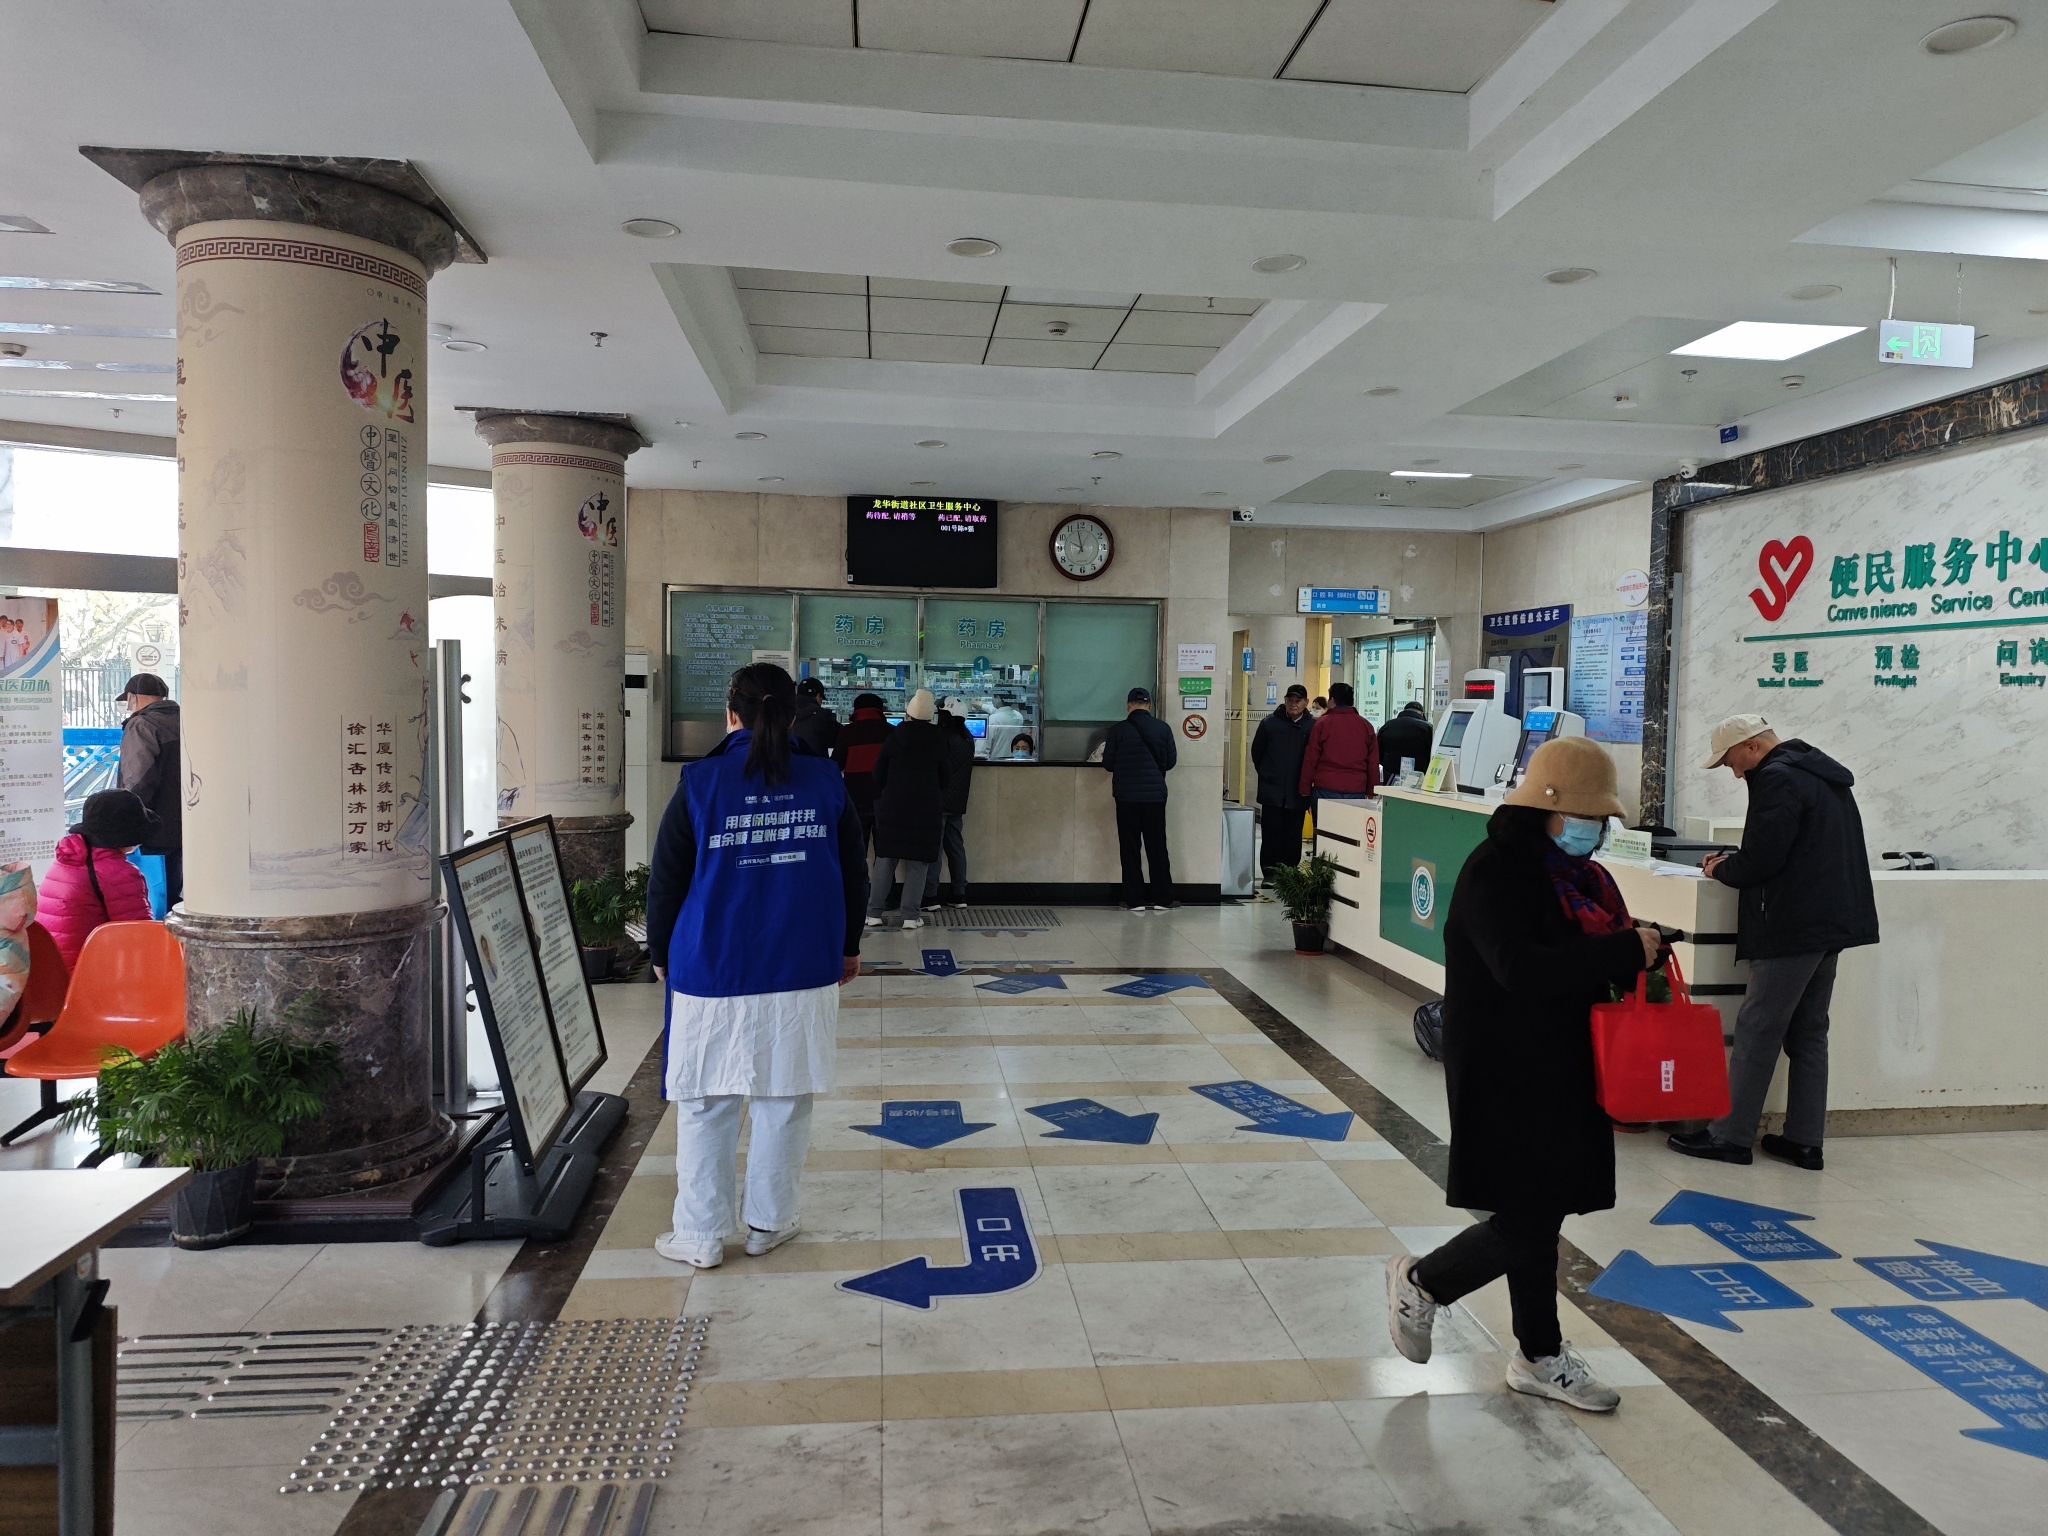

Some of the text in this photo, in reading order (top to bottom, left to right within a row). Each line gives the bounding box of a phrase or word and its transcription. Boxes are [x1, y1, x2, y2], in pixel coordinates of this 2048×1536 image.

[872, 499, 981, 511] 龙华街道社区卫生服务中心
[1827, 599, 1917, 622] Convenience
[1931, 591, 1993, 615] Service
[835, 614, 885, 635] 药房
[958, 617, 1006, 638] 药房
[1489, 608, 1560, 627] 卫生监督信息公示栏
[837, 636, 881, 648] Pharmacy
[960, 640, 1003, 650] Pharmacy
[856, 655, 863, 667] 2
[978, 659, 984, 669] 1
[1875, 644, 1920, 671] 预检
[2000, 672, 2046, 687] Enquiry
[581, 712, 592, 784] 徐汇杏林济万家
[347, 722, 368, 854] 徐汇杏林济万家
[376, 722, 394, 852] 华厦传统新时代
[725, 809, 816, 830] 用医保码就找我
[708, 831, 748, 849] 查余额
[750, 827, 790, 844] 查账单
[976, 1218, 1020, 1262] 出口
[1691, 1268, 1769, 1304] 出口
[1919, 1259, 2008, 1295] 抽血
[1554, 1373, 1574, 1389] N
